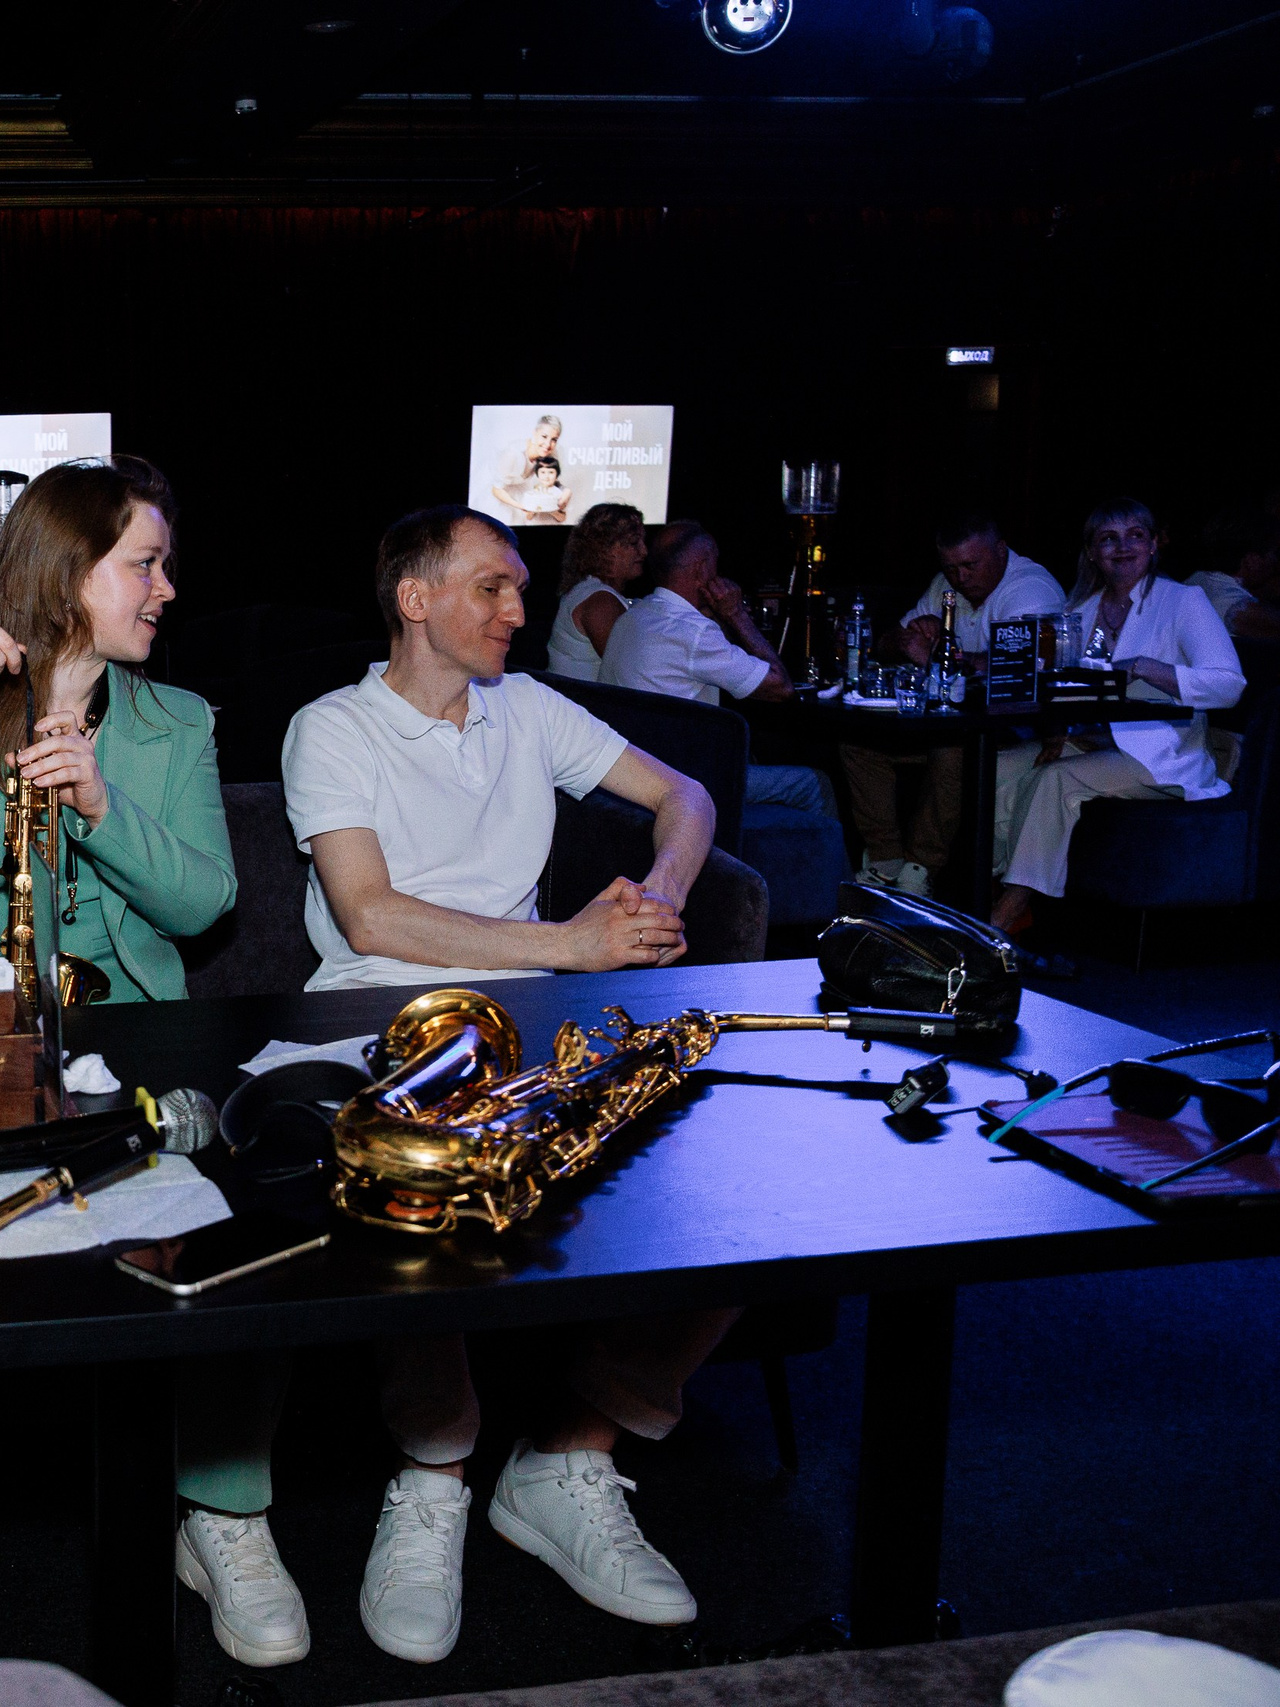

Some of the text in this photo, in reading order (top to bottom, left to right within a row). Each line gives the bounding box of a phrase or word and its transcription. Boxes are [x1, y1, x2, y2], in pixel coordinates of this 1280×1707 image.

[34, 428, 68, 451] МОЙ
[602, 419, 633, 442] МОЙ
[568, 443, 663, 466] СЧАСТЛИВЫЙ
[593, 470, 632, 491] ДЕНЬ
